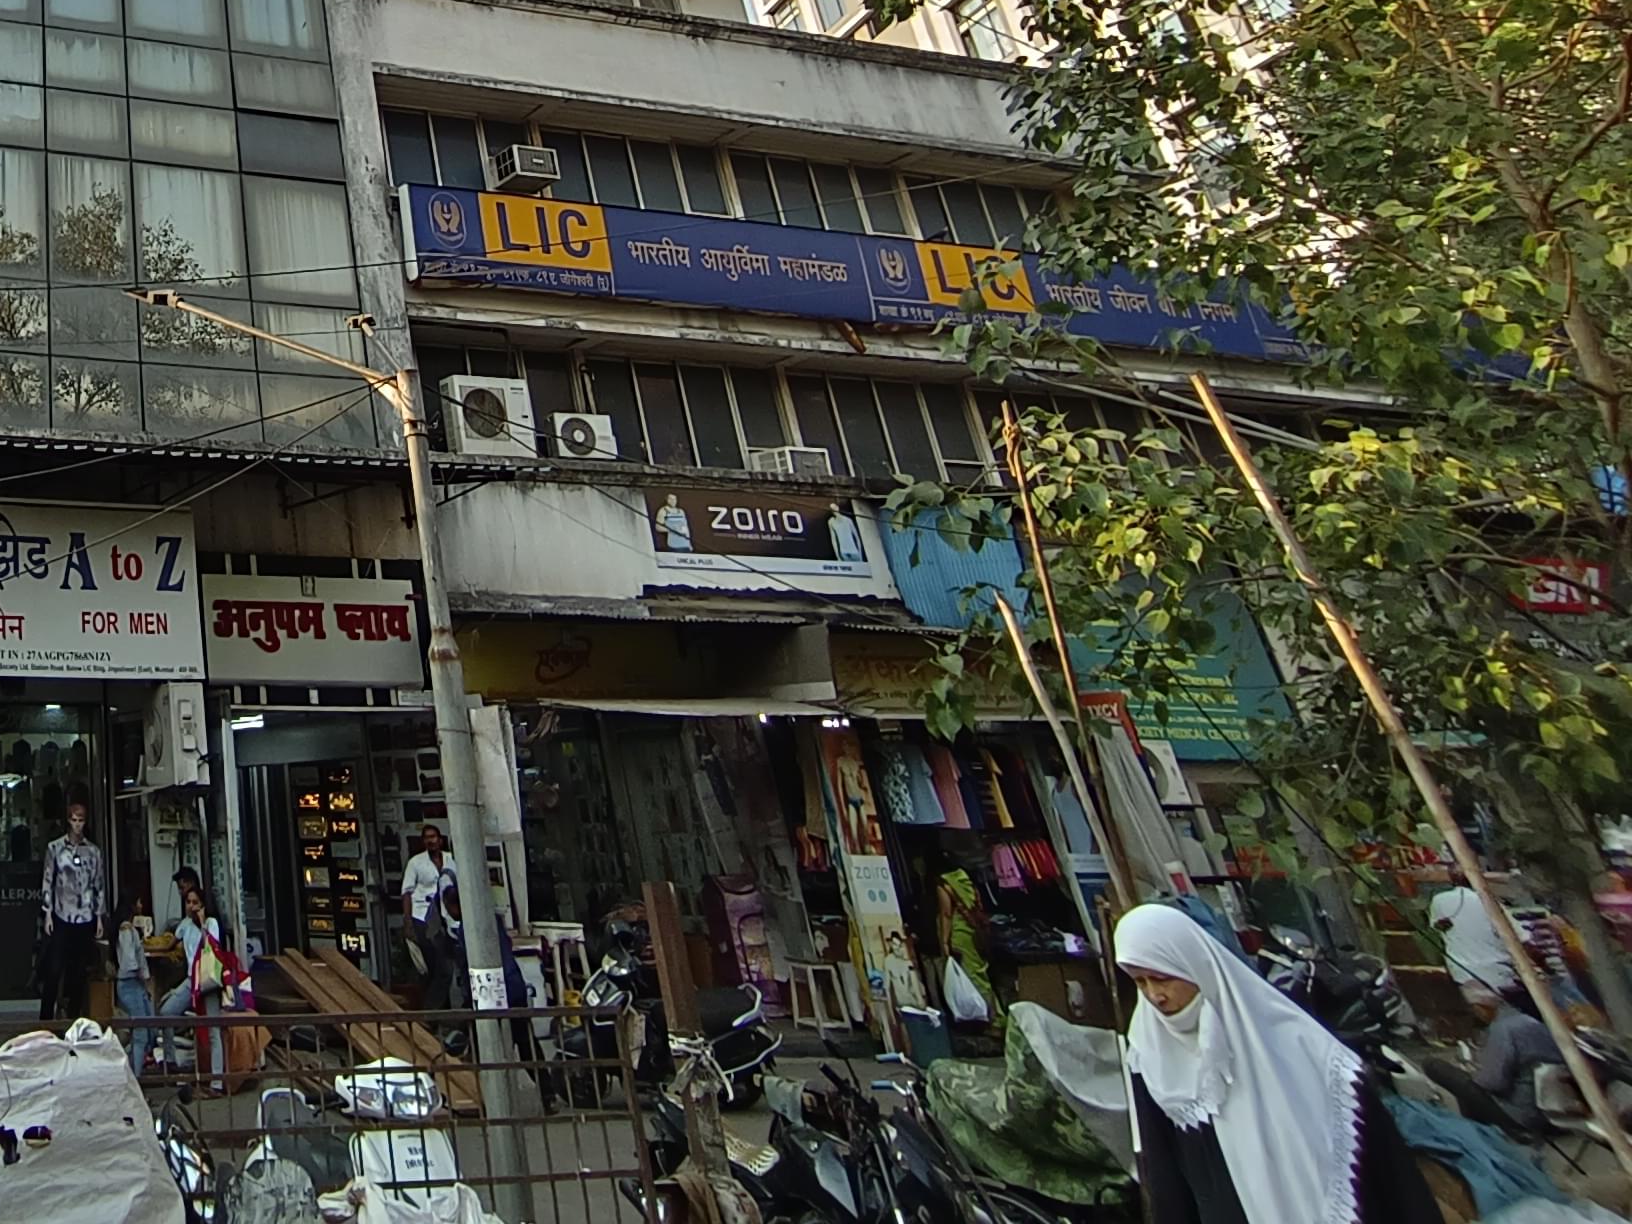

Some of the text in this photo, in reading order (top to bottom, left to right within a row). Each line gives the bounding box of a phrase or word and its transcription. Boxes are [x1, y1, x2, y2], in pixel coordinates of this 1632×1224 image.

[496, 202, 592, 259] LIC
[628, 237, 691, 269] भारतीय
[778, 253, 847, 283] महामंडळ
[931, 250, 1020, 300] LIC
[1107, 285, 1153, 313] जीवन
[59, 532, 186, 592] A to Z
[81, 611, 168, 635] FOR MEN
[212, 599, 326, 653] अनुपम
